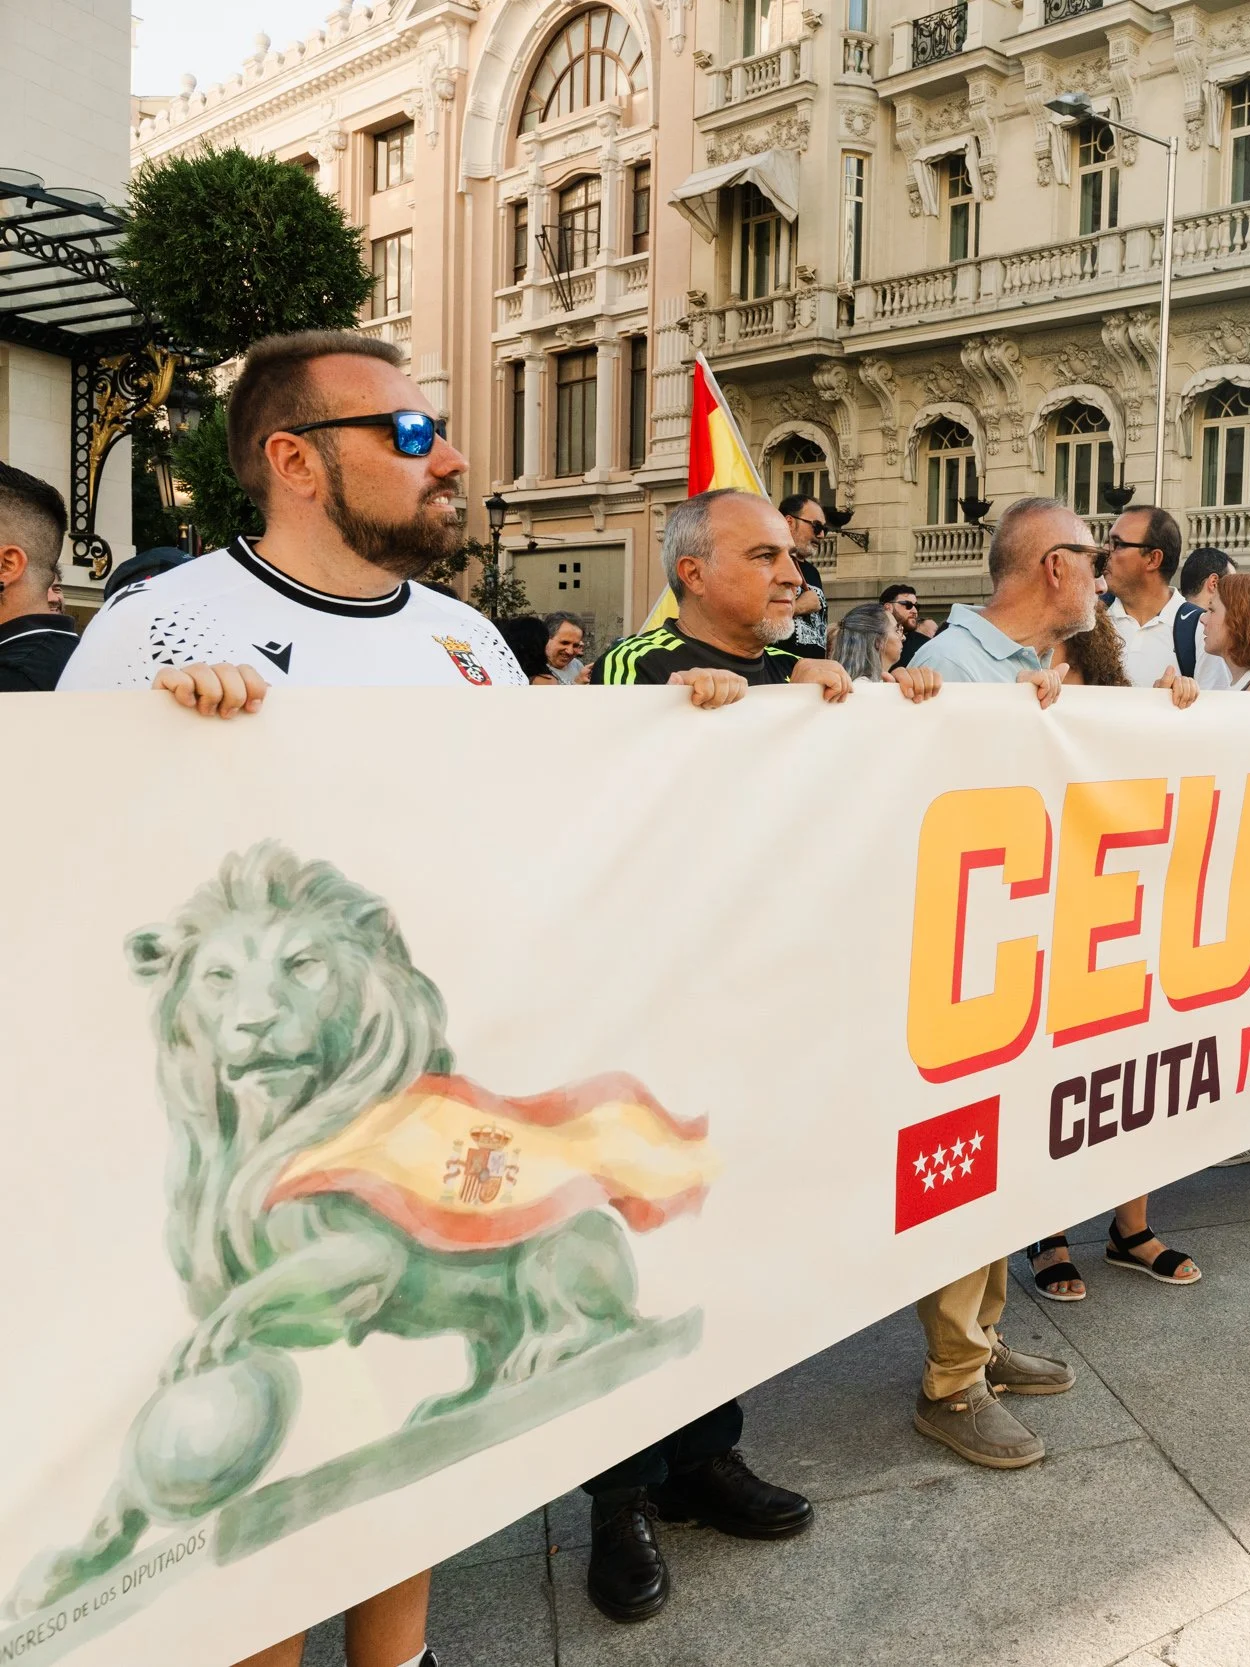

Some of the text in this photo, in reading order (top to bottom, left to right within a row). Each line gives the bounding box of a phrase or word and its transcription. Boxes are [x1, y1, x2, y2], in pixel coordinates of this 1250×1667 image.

[1048, 1036, 1221, 1161] CEUTA
[0, 1529, 207, 1665] NGRESO DE LOS DIPUTADOS
